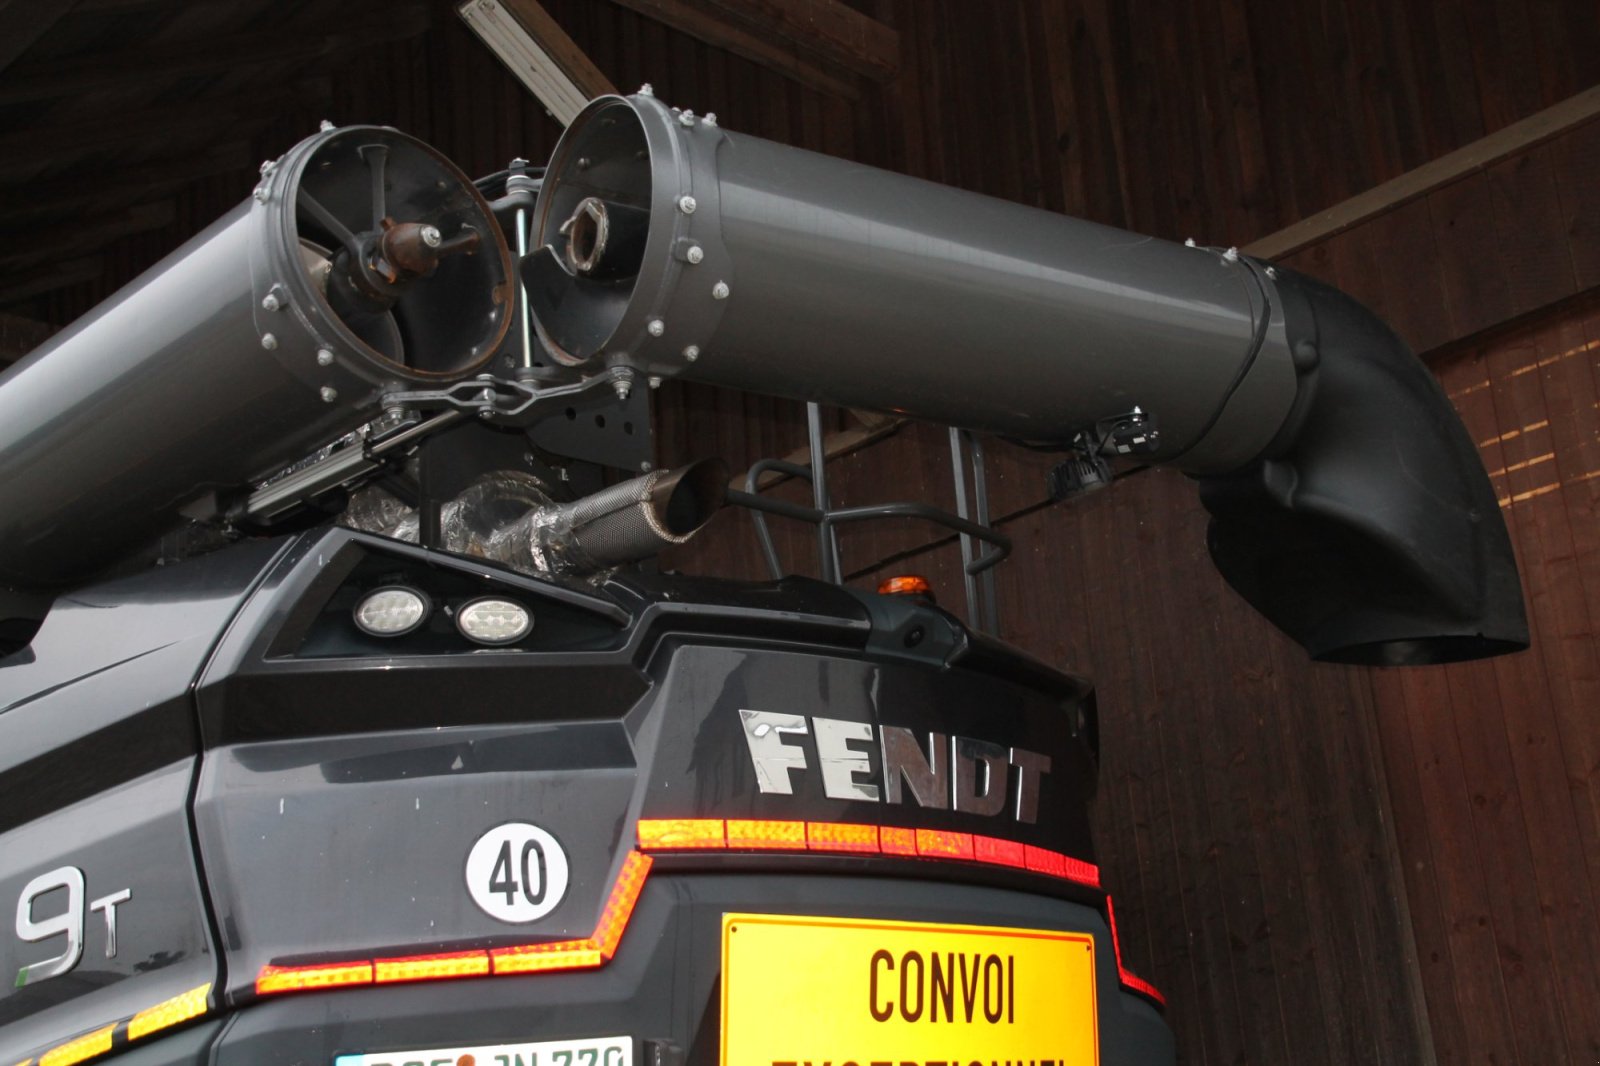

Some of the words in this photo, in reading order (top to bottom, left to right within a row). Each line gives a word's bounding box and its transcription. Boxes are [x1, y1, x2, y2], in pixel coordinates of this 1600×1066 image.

[738, 709, 1051, 825] FENDT
[489, 839, 547, 906] 40
[869, 949, 1014, 1024] CONVOI
